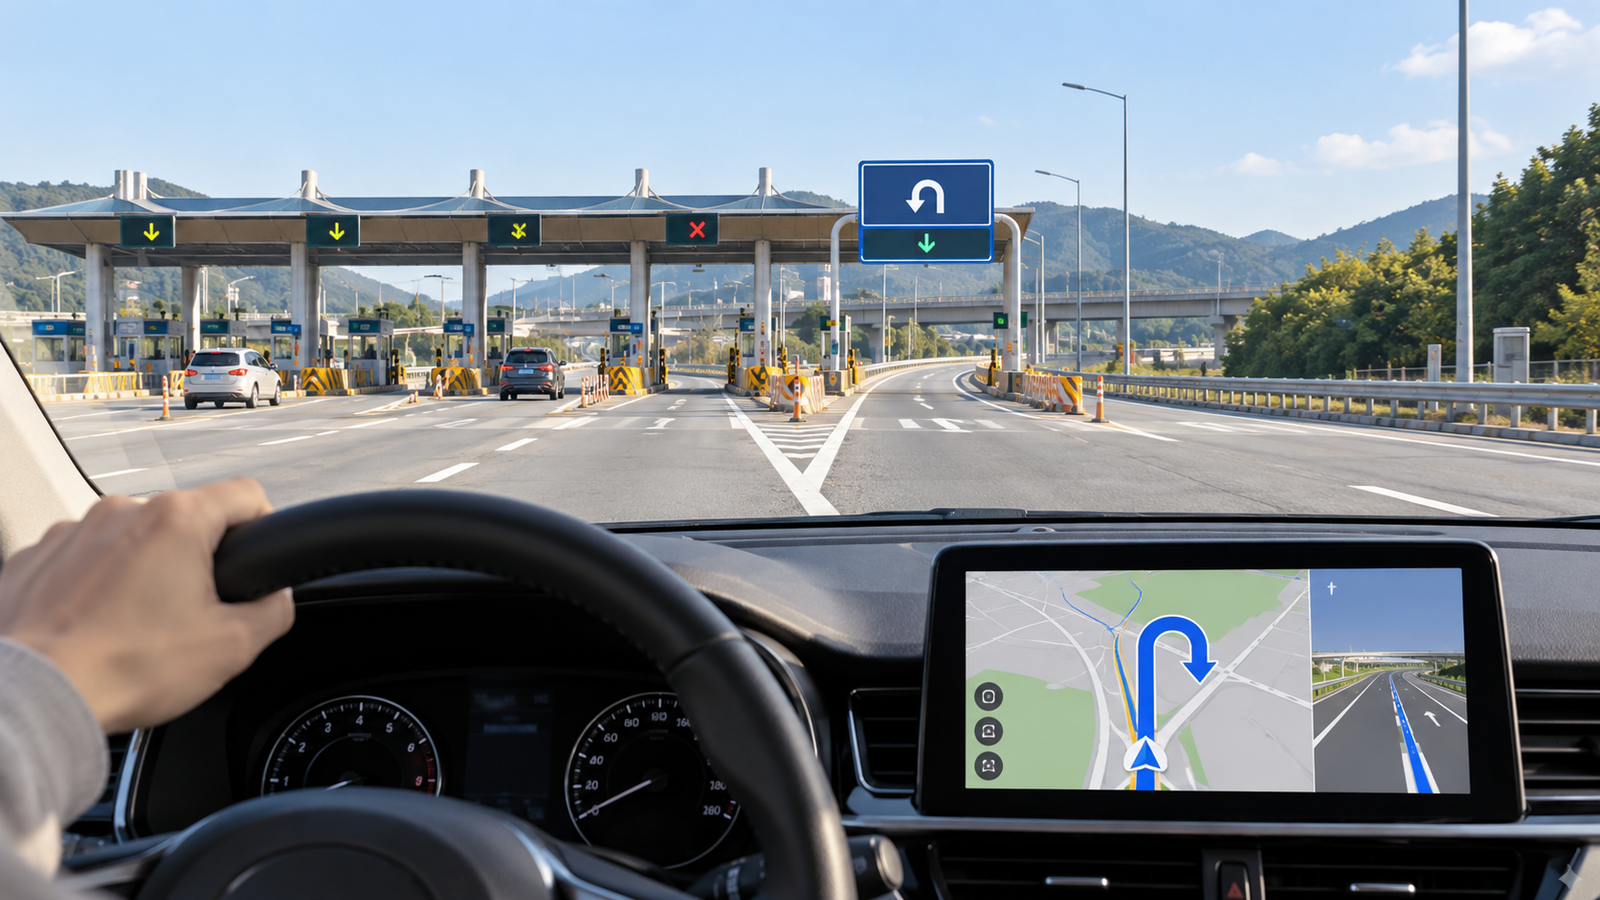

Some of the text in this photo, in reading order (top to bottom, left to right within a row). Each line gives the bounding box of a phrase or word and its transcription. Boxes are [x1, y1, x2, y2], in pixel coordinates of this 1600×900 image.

[356, 715, 363, 725] 4
[325, 722, 332, 733] 3
[396, 722, 403, 733] 5
[604, 733, 618, 742] 60
[298, 742, 306, 752] 2
[589, 756, 603, 765] 40
[283, 776, 289, 786] 1
[585, 780, 598, 790] 20
